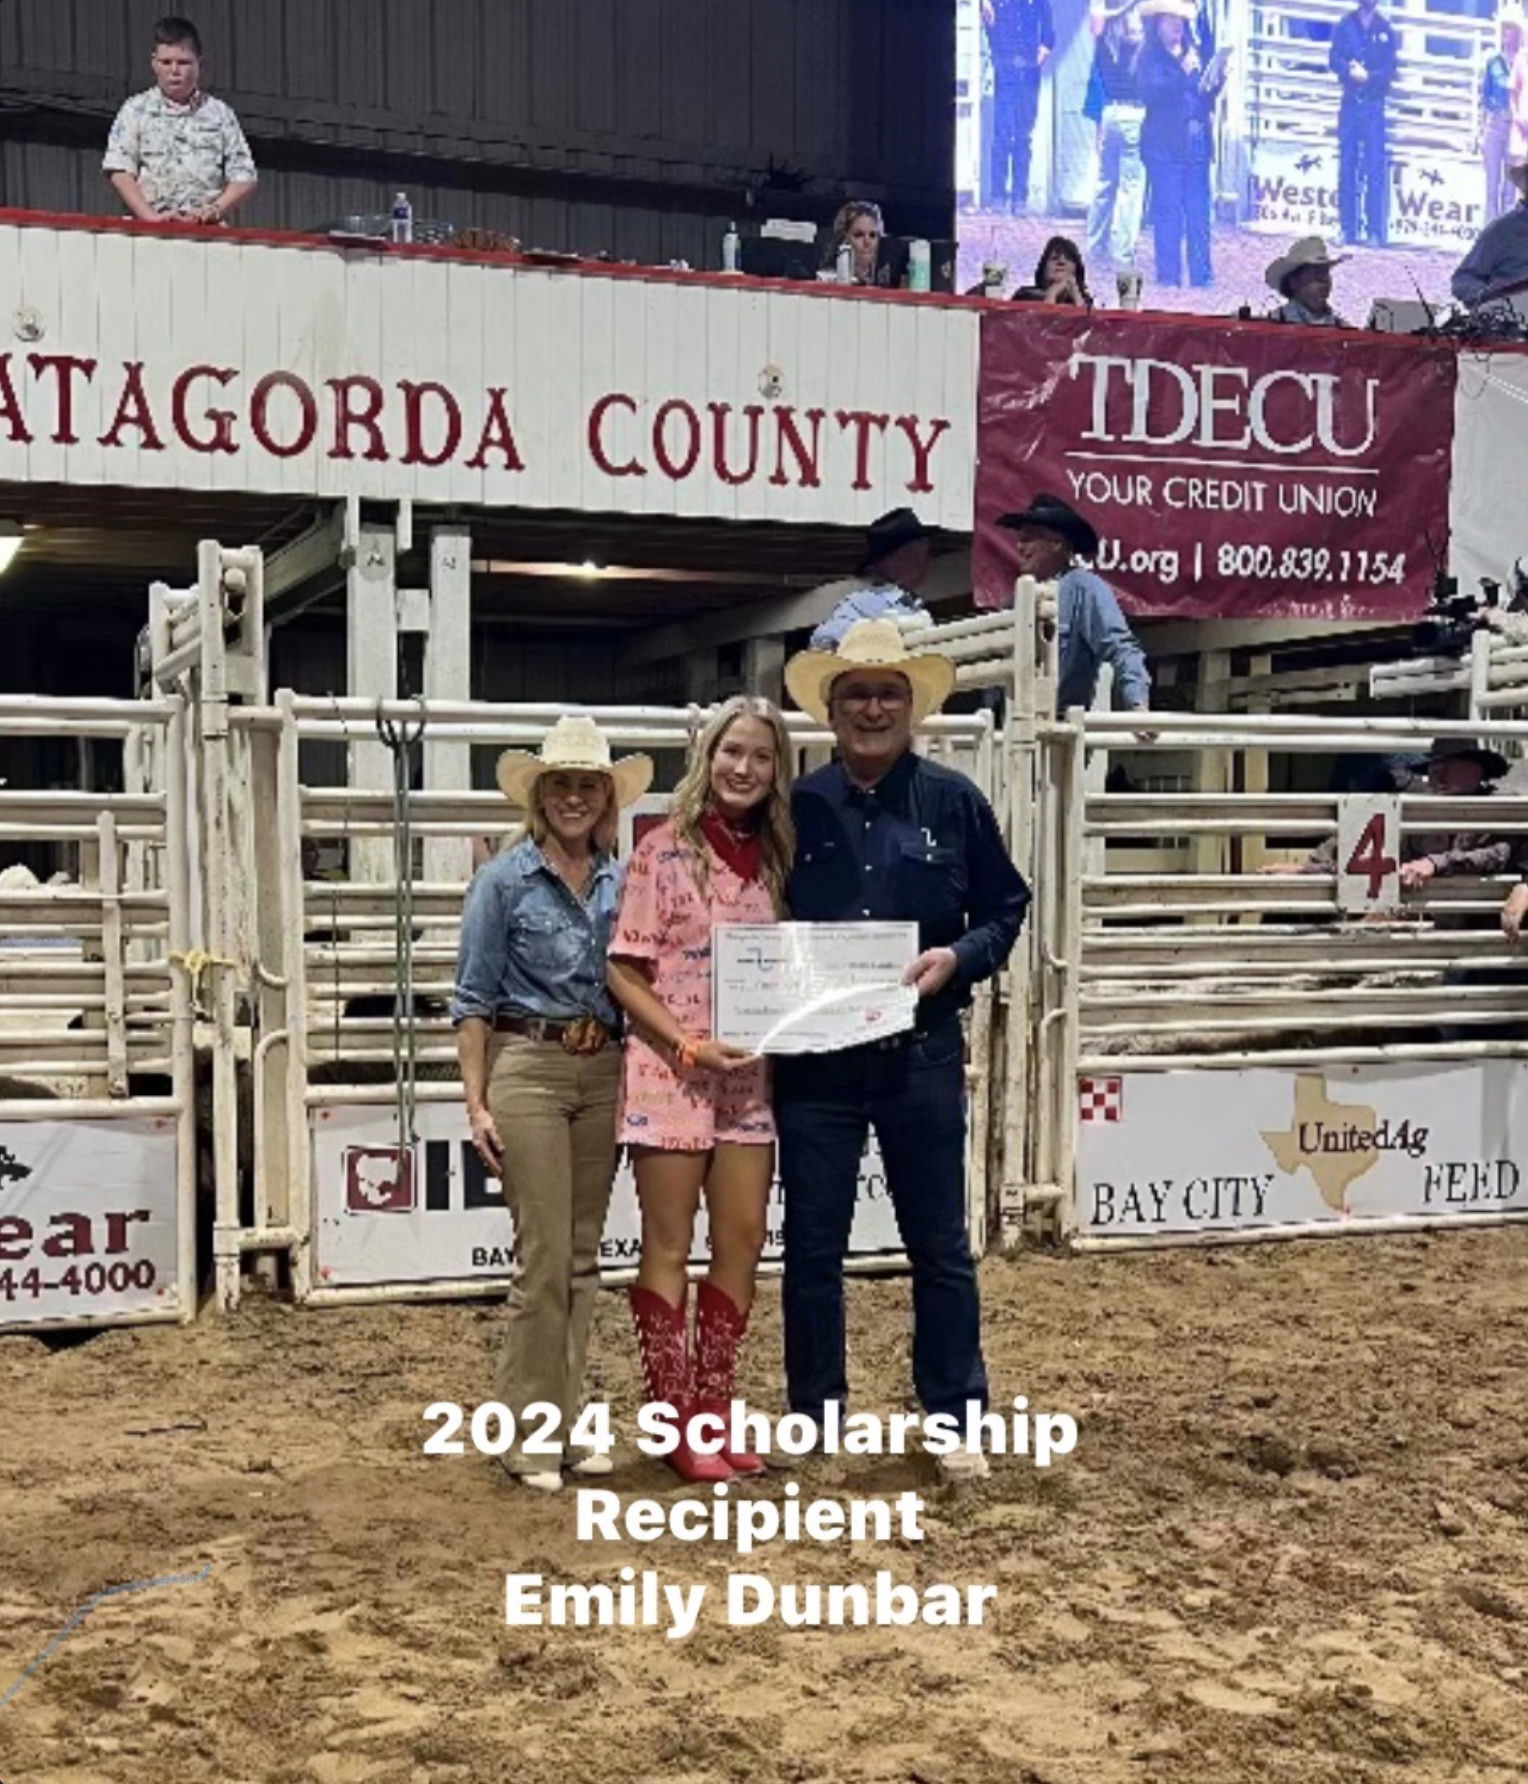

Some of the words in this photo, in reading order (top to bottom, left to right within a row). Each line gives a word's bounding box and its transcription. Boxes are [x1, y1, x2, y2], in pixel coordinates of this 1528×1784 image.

[1395, 189, 1482, 223] Wear
[1069, 353, 1380, 457] TDECU
[587, 394, 951, 493] COUNTY
[1067, 470, 1153, 505] YOUR
[1163, 476, 1267, 513] CREDIT
[1279, 484, 1377, 518] UNION
[1217, 542, 1406, 585] 800.839.1154
[1346, 812, 1397, 900] 4
[1299, 1118, 1430, 1158] UnitedAg
[1090, 1179, 1174, 1226] BAY
[1182, 1174, 1276, 1220] CITY
[1423, 1158, 1521, 1205] FEED
